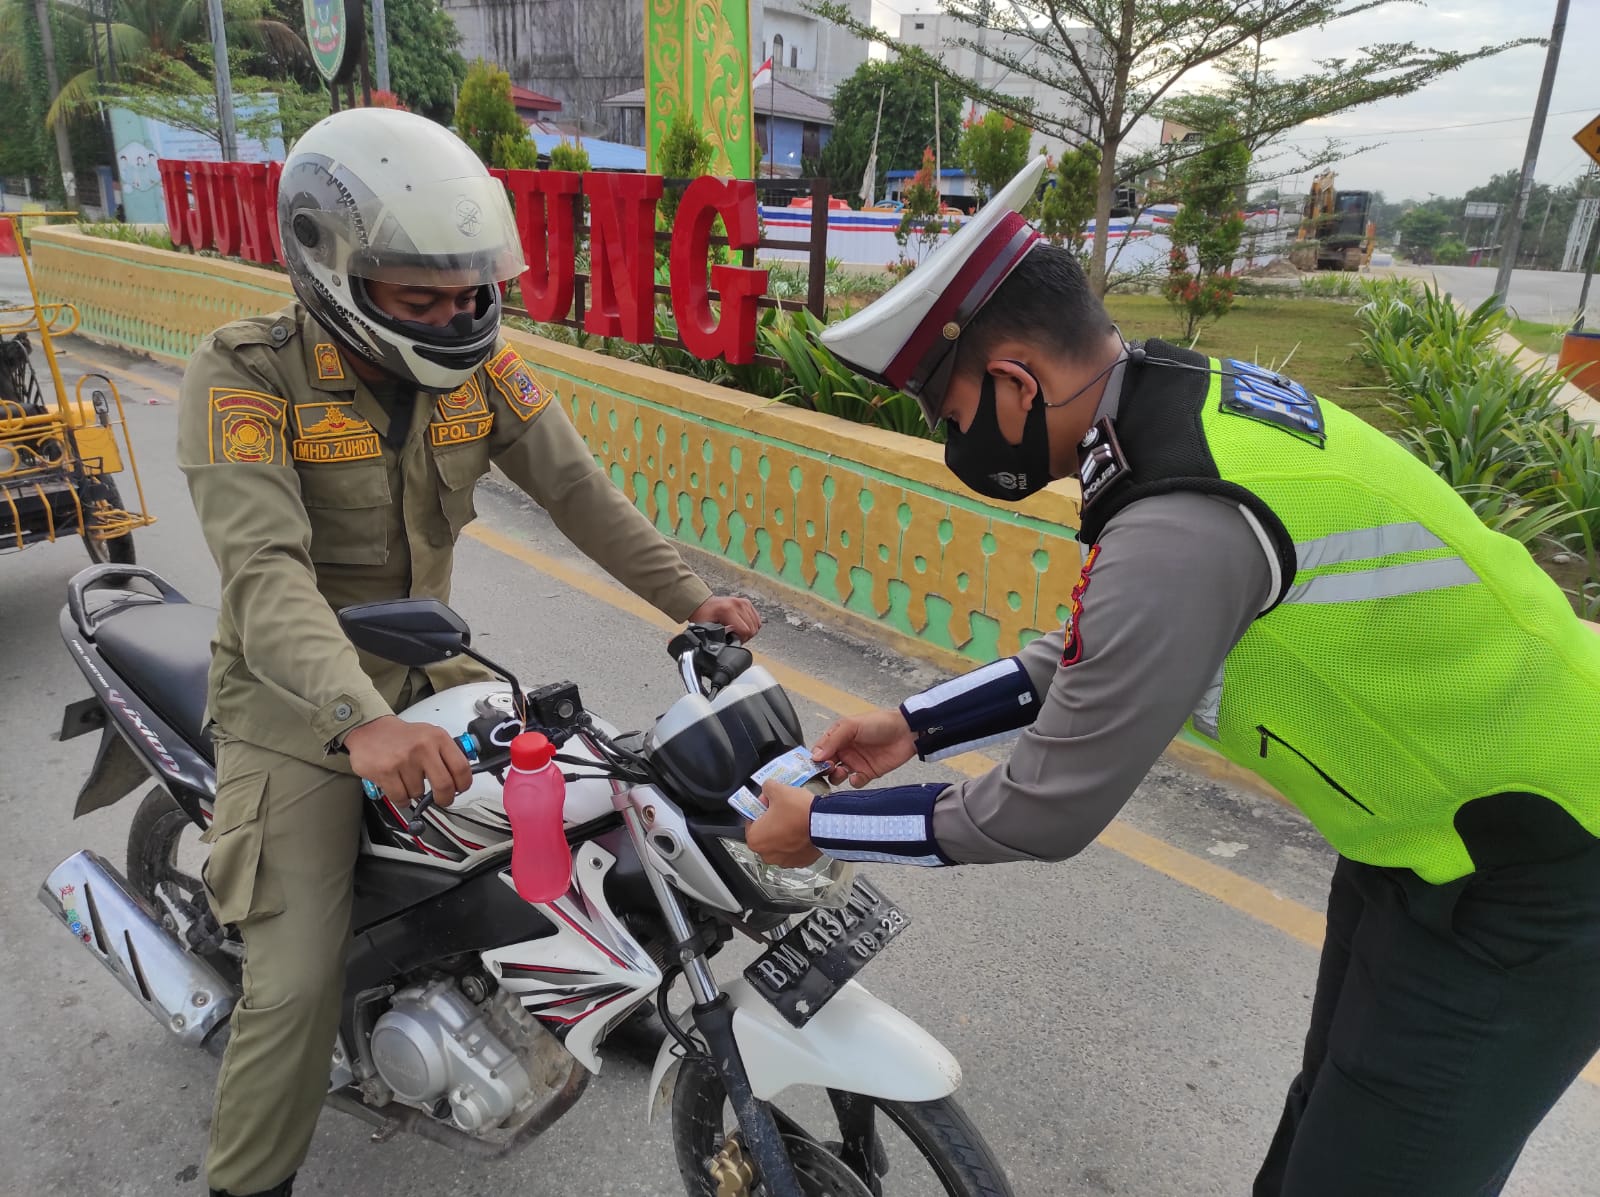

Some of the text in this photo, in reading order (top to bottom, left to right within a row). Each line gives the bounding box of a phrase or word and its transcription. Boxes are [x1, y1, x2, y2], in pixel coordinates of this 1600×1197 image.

[488, 168, 769, 366] UNG
[438, 424, 471, 442] POL
[1018, 473, 1027, 490] POLRI
[881, 909, 905, 934] 23
[757, 943, 810, 990] BM
